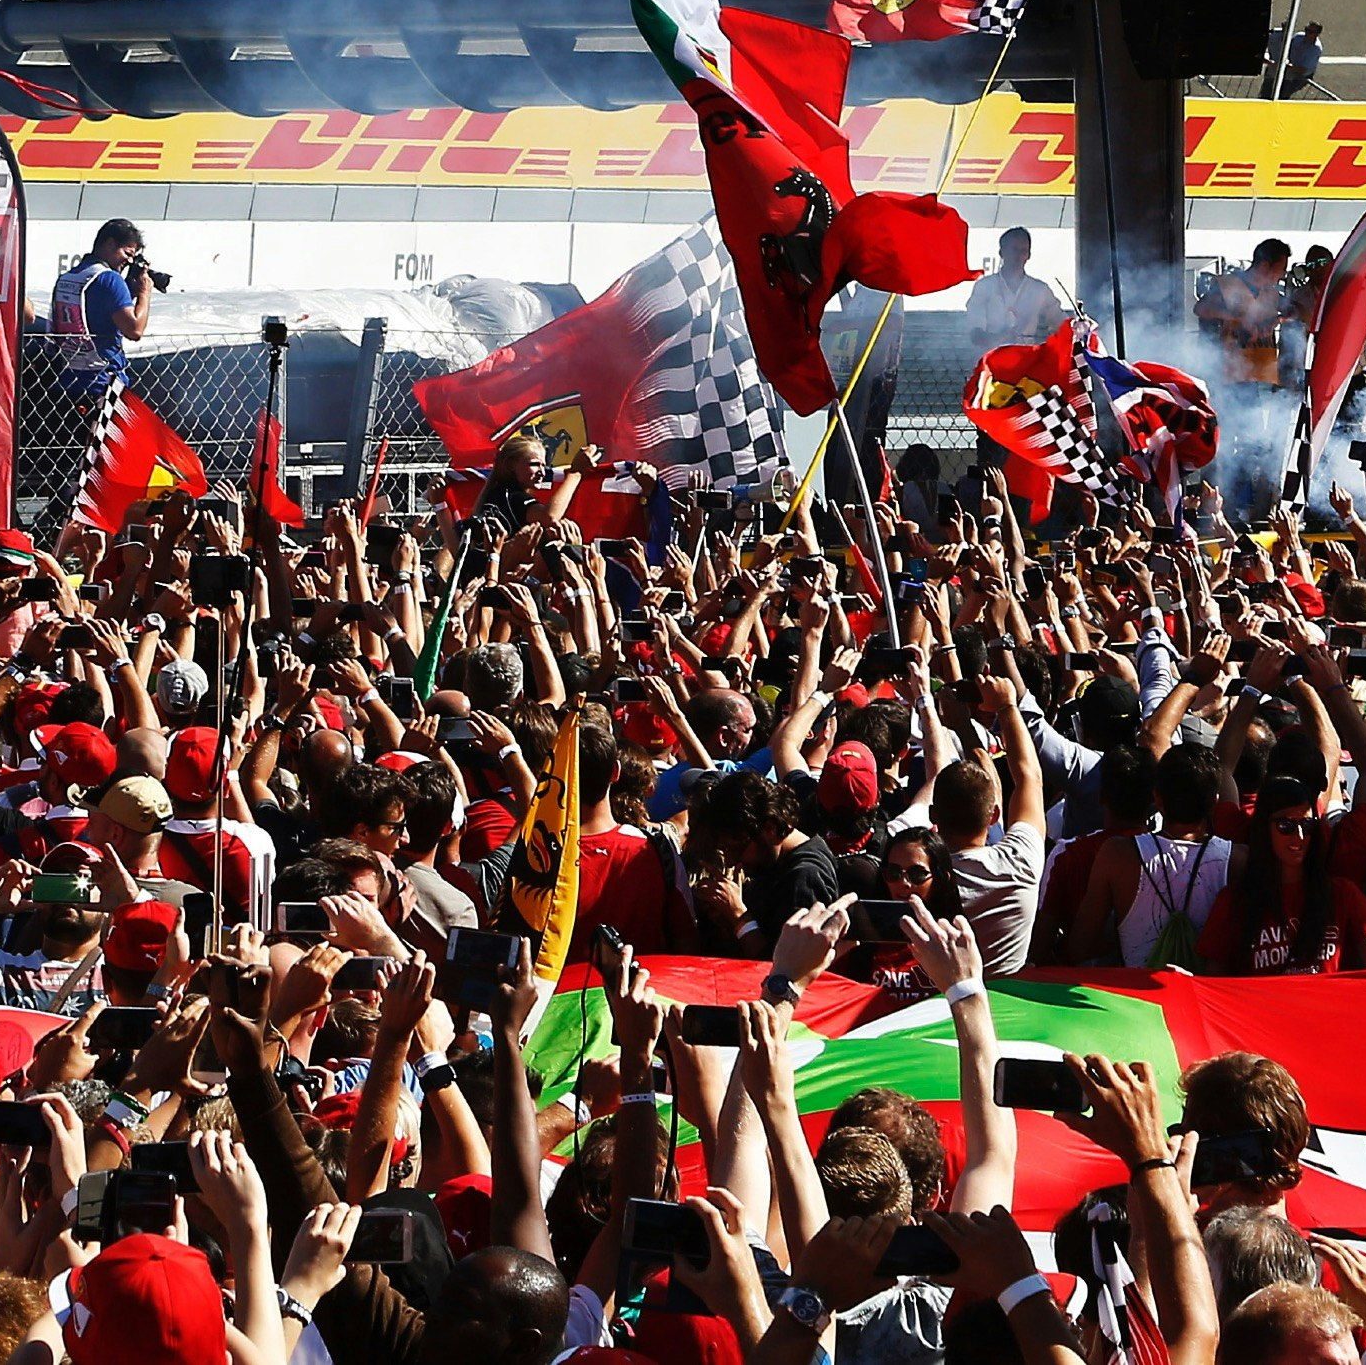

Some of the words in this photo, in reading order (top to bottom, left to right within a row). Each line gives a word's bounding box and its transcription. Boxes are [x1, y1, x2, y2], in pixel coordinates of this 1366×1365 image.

[245, 106, 525, 173] DHL
[395, 253, 433, 281] FOM
[872, 969, 912, 989] SAVE
